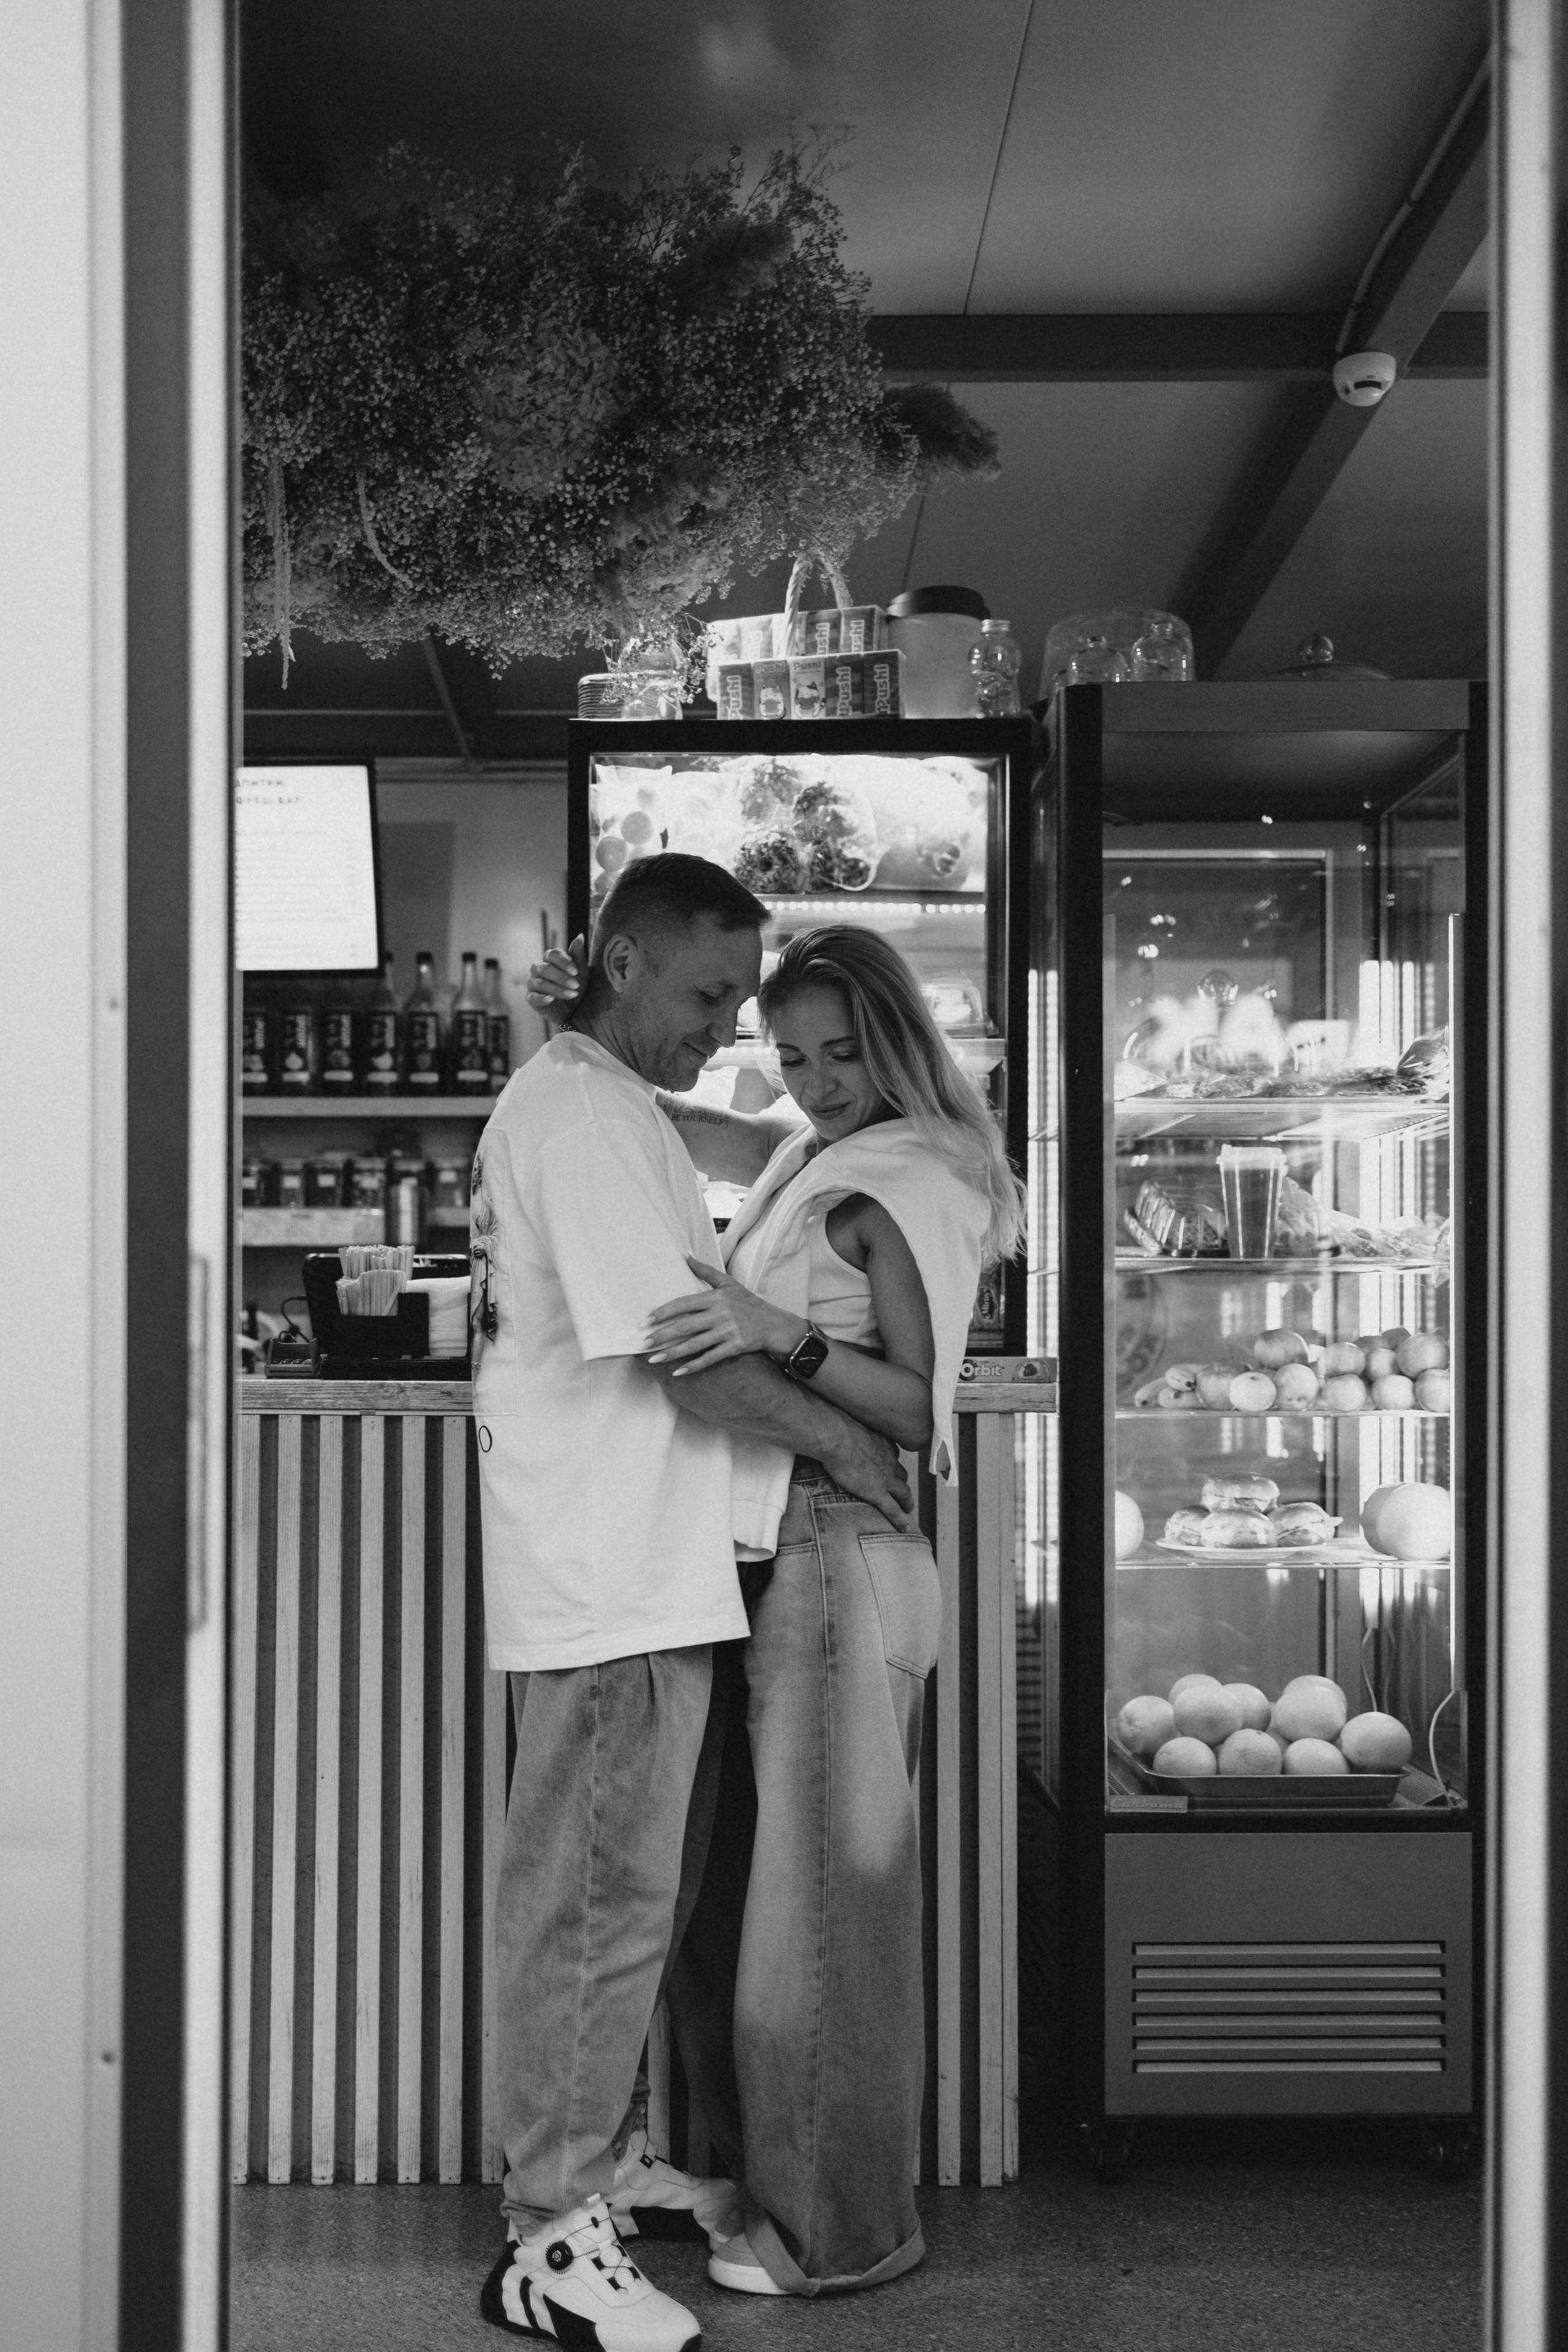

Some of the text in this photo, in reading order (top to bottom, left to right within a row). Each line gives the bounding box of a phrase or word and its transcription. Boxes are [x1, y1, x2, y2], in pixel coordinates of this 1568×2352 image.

[815, 623, 830, 655] ushi
[851, 620, 865, 652] ushi
[756, 663, 786, 673] Pushi
[794, 662, 821, 671] Pushi
[836, 666, 852, 714] Pushi
[874, 664, 890, 712] Pushi
[682, 1114, 725, 1126] YOURSELF
[960, 1362, 1002, 1378] Orbit
[1111, 1798, 1183, 1808] Carboma
